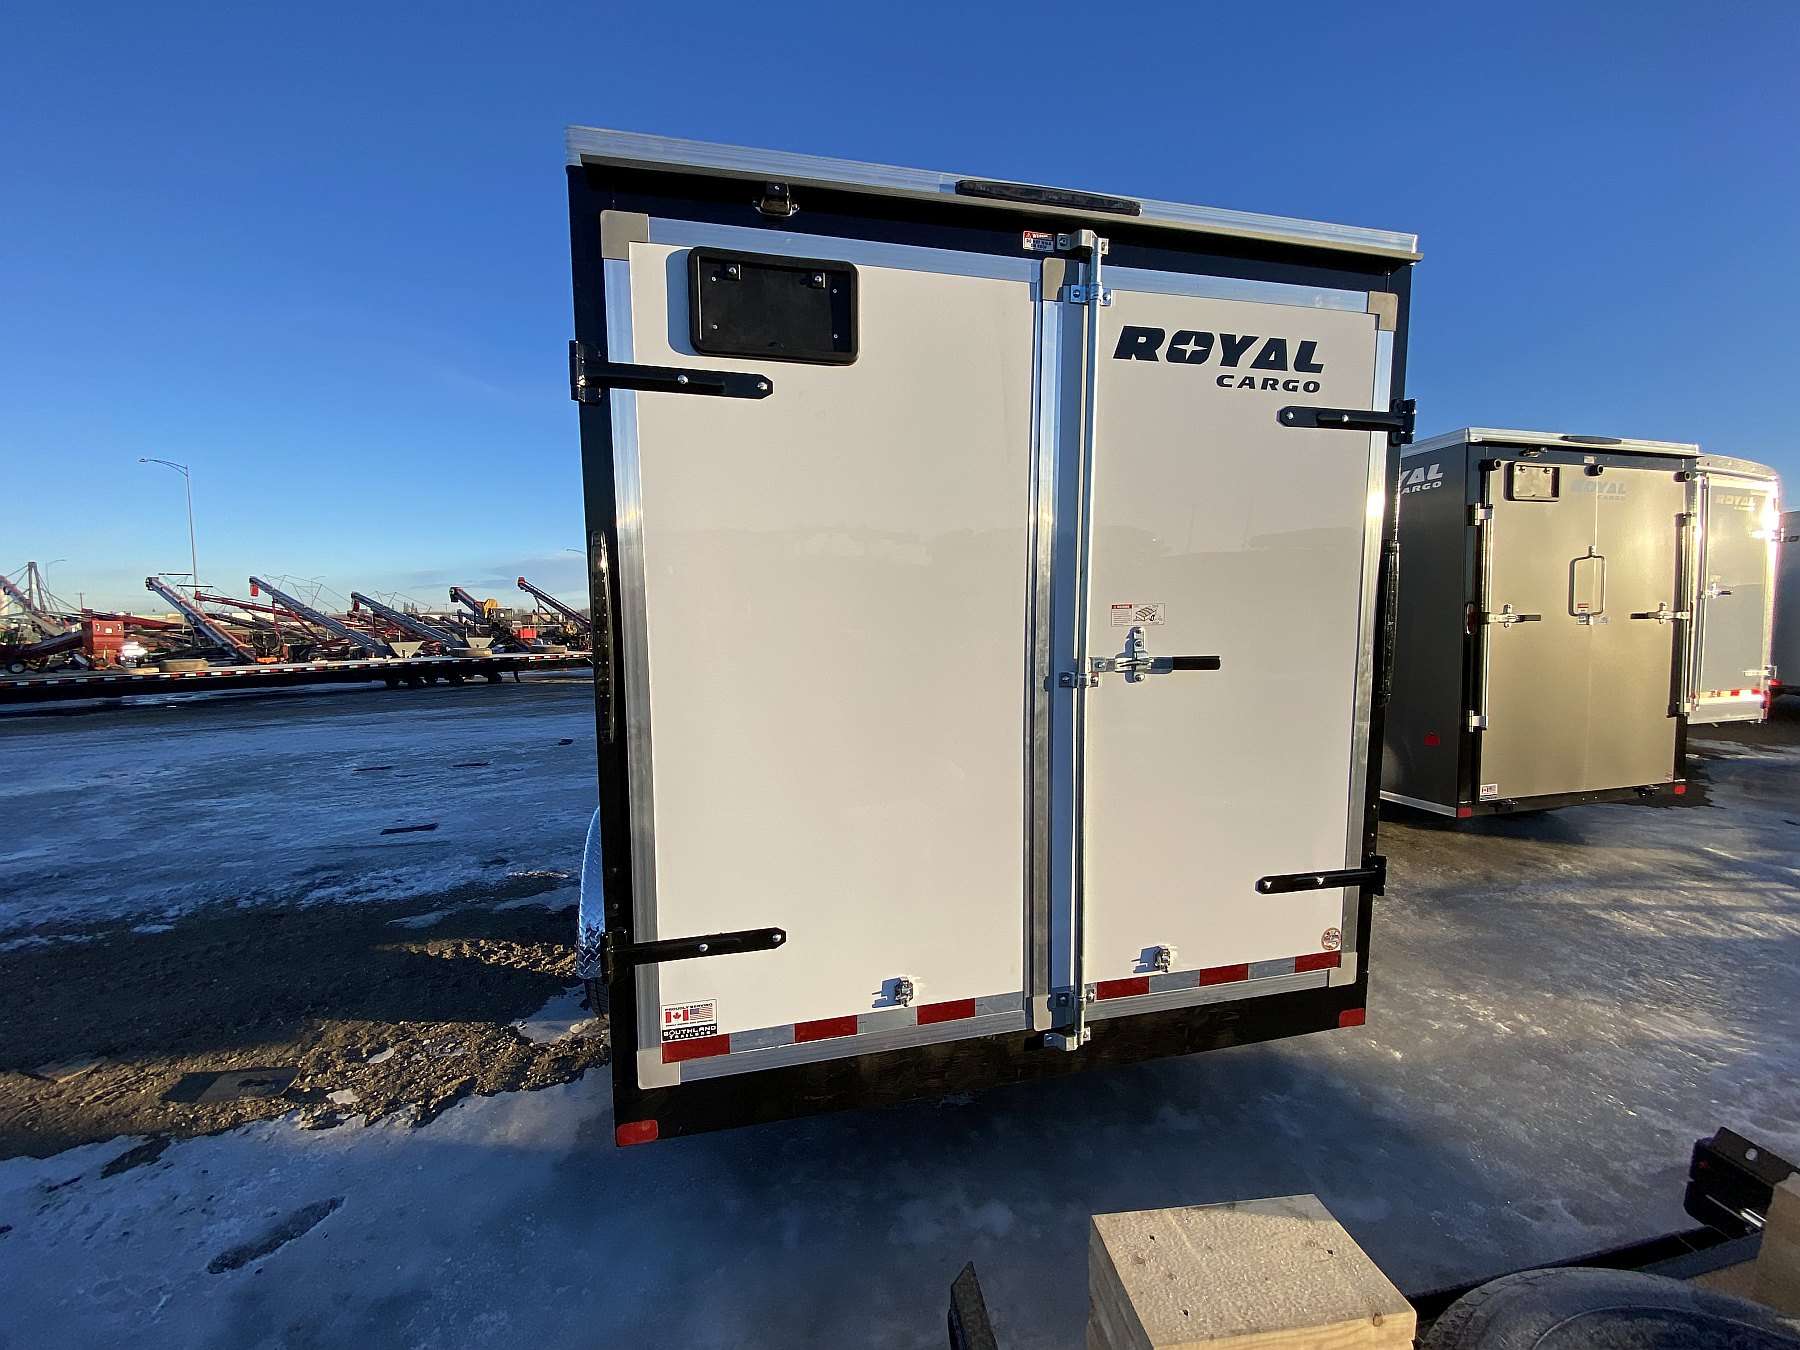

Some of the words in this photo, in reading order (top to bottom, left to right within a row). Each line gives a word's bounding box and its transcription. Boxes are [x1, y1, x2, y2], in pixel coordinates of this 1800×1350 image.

[1112, 325, 1325, 374] ROYAL
[1215, 374, 1321, 393] CARGO
[1401, 463, 1443, 487] YAL
[1401, 481, 1441, 494] ARGO
[663, 1026, 716, 1037] SOUTHLAND
